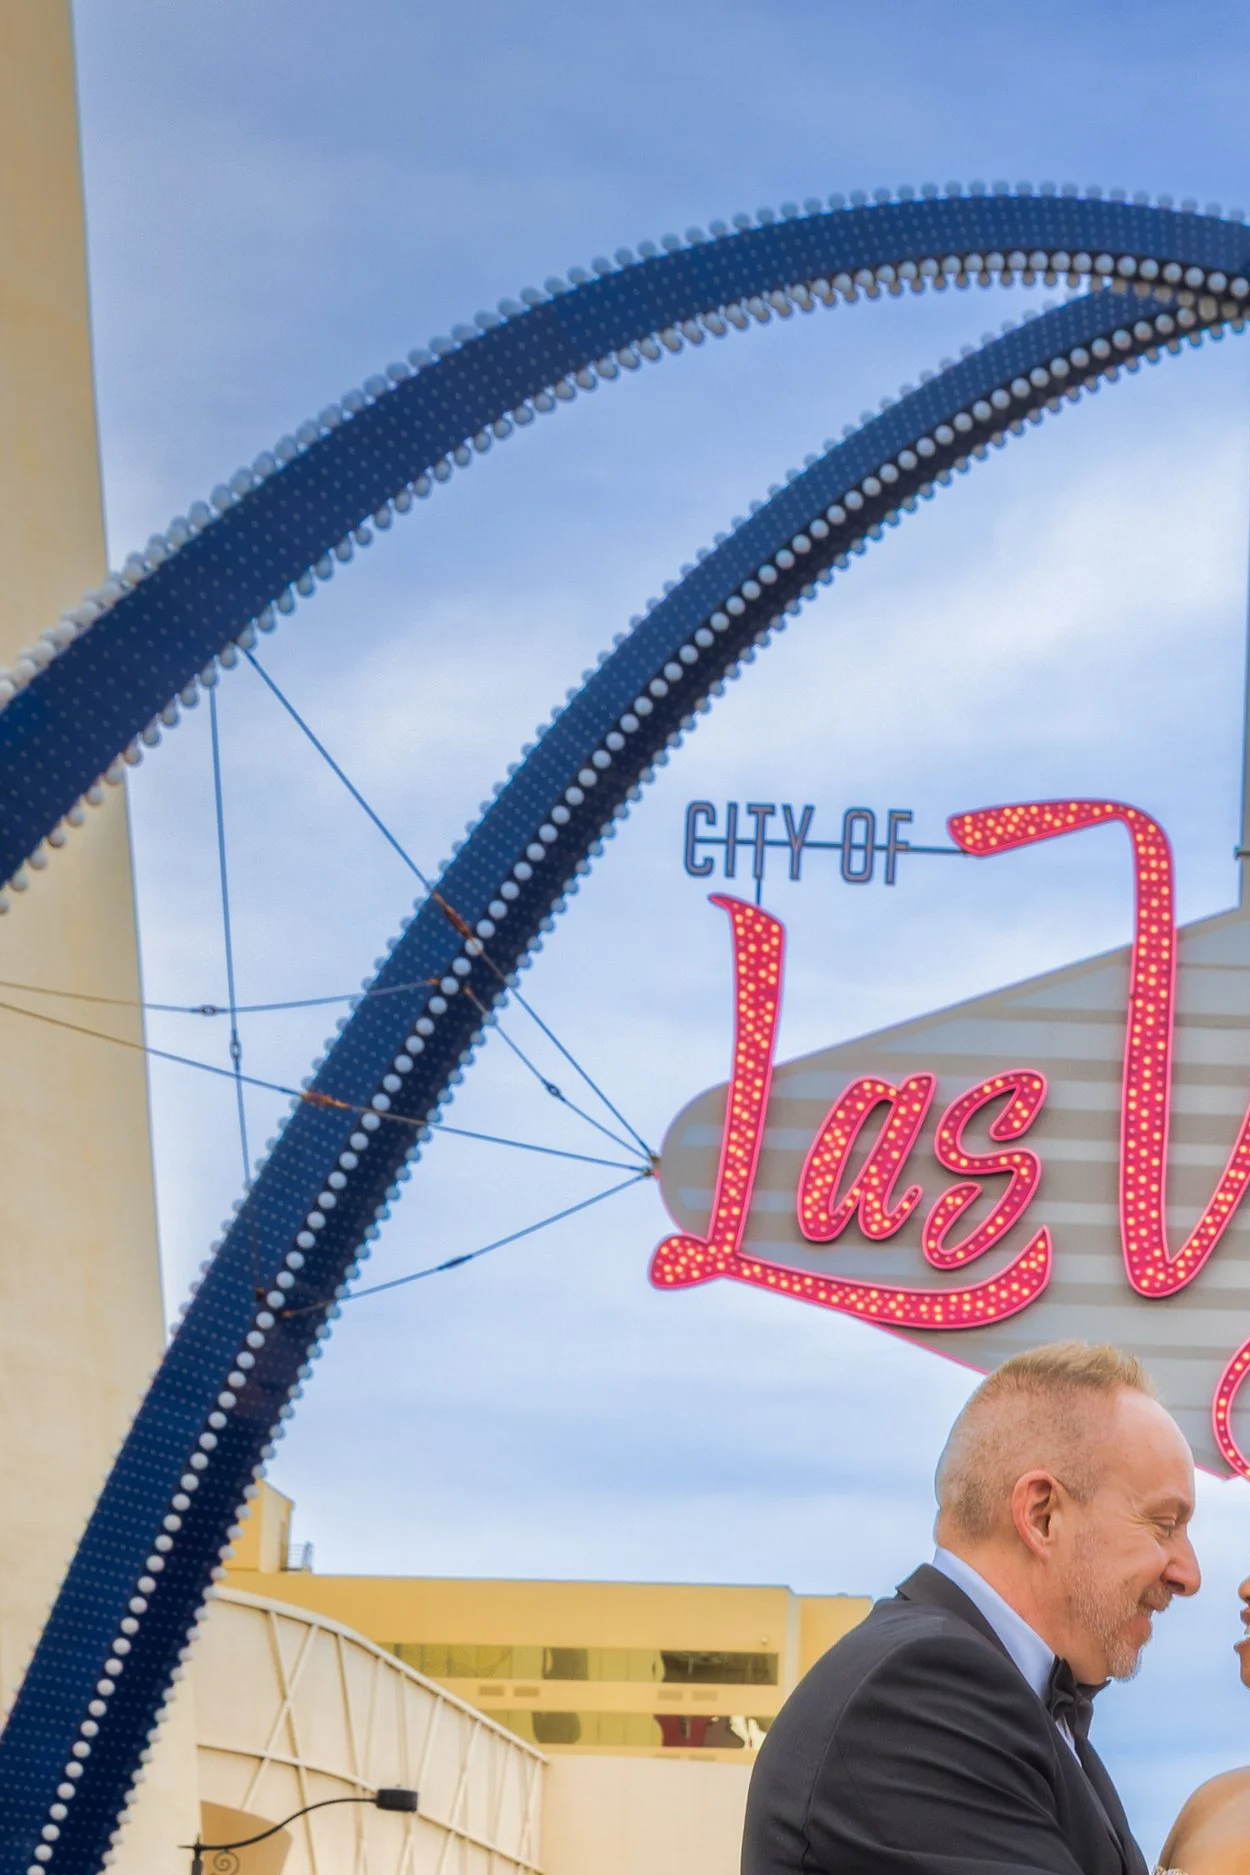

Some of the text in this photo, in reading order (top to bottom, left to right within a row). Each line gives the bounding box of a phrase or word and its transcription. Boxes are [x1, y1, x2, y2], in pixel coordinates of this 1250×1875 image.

[685, 799, 914, 886] CITY OF
[649, 892, 1053, 1332] Las
